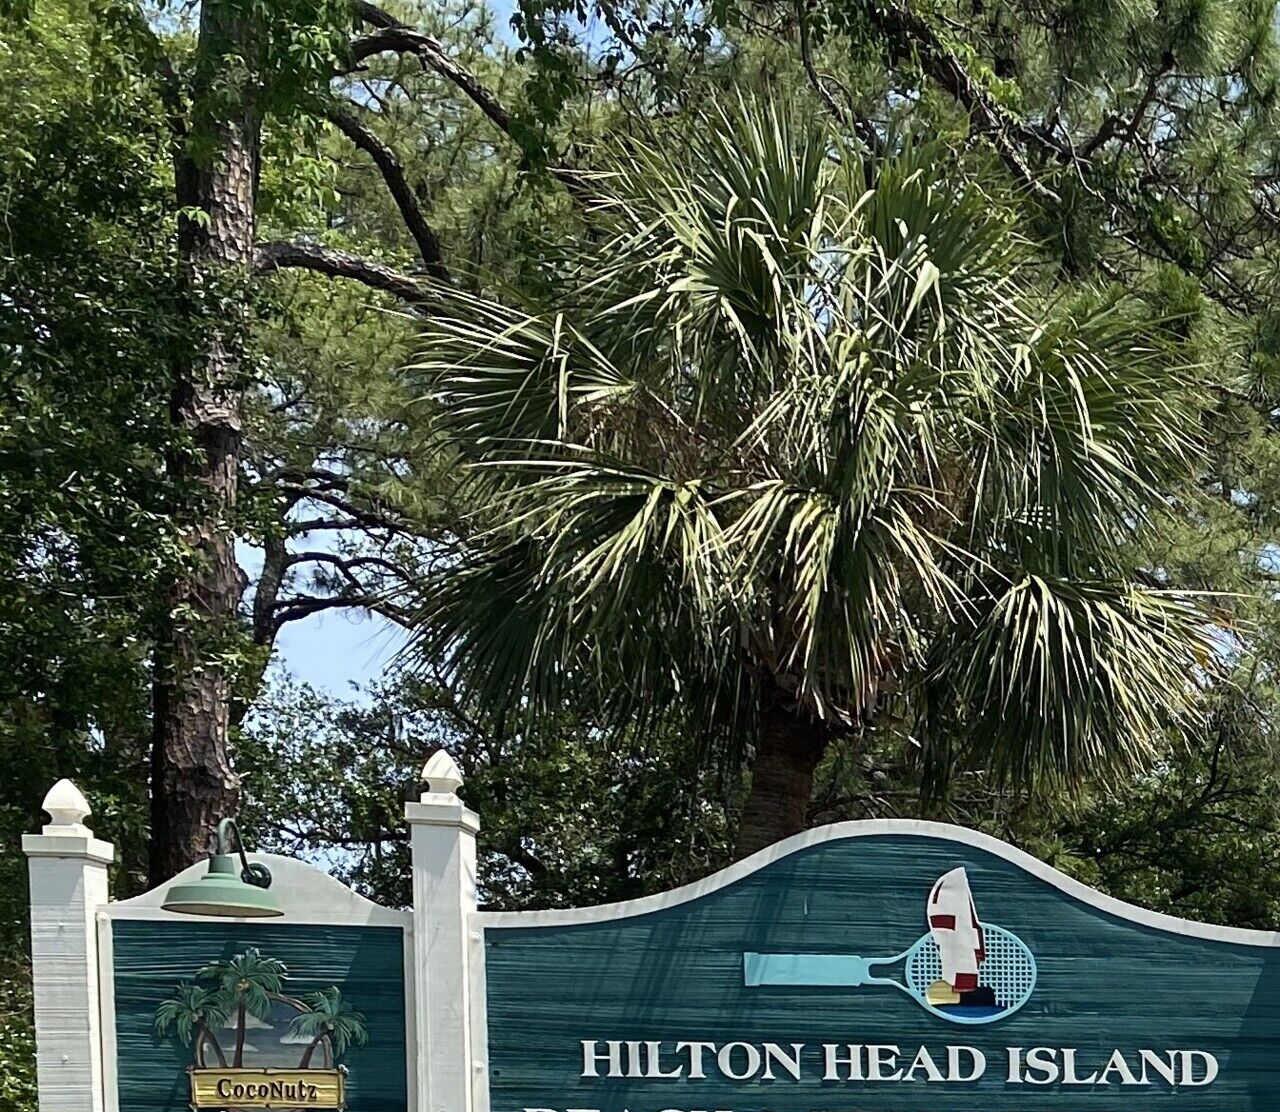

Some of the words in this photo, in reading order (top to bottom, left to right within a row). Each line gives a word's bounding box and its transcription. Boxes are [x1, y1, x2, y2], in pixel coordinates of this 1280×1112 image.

[580, 1040, 805, 1080] HILTON
[822, 1043, 986, 1082] HEAD
[1005, 1047, 1219, 1086] ISLAND
[216, 1078, 318, 1101] CocoNutz
